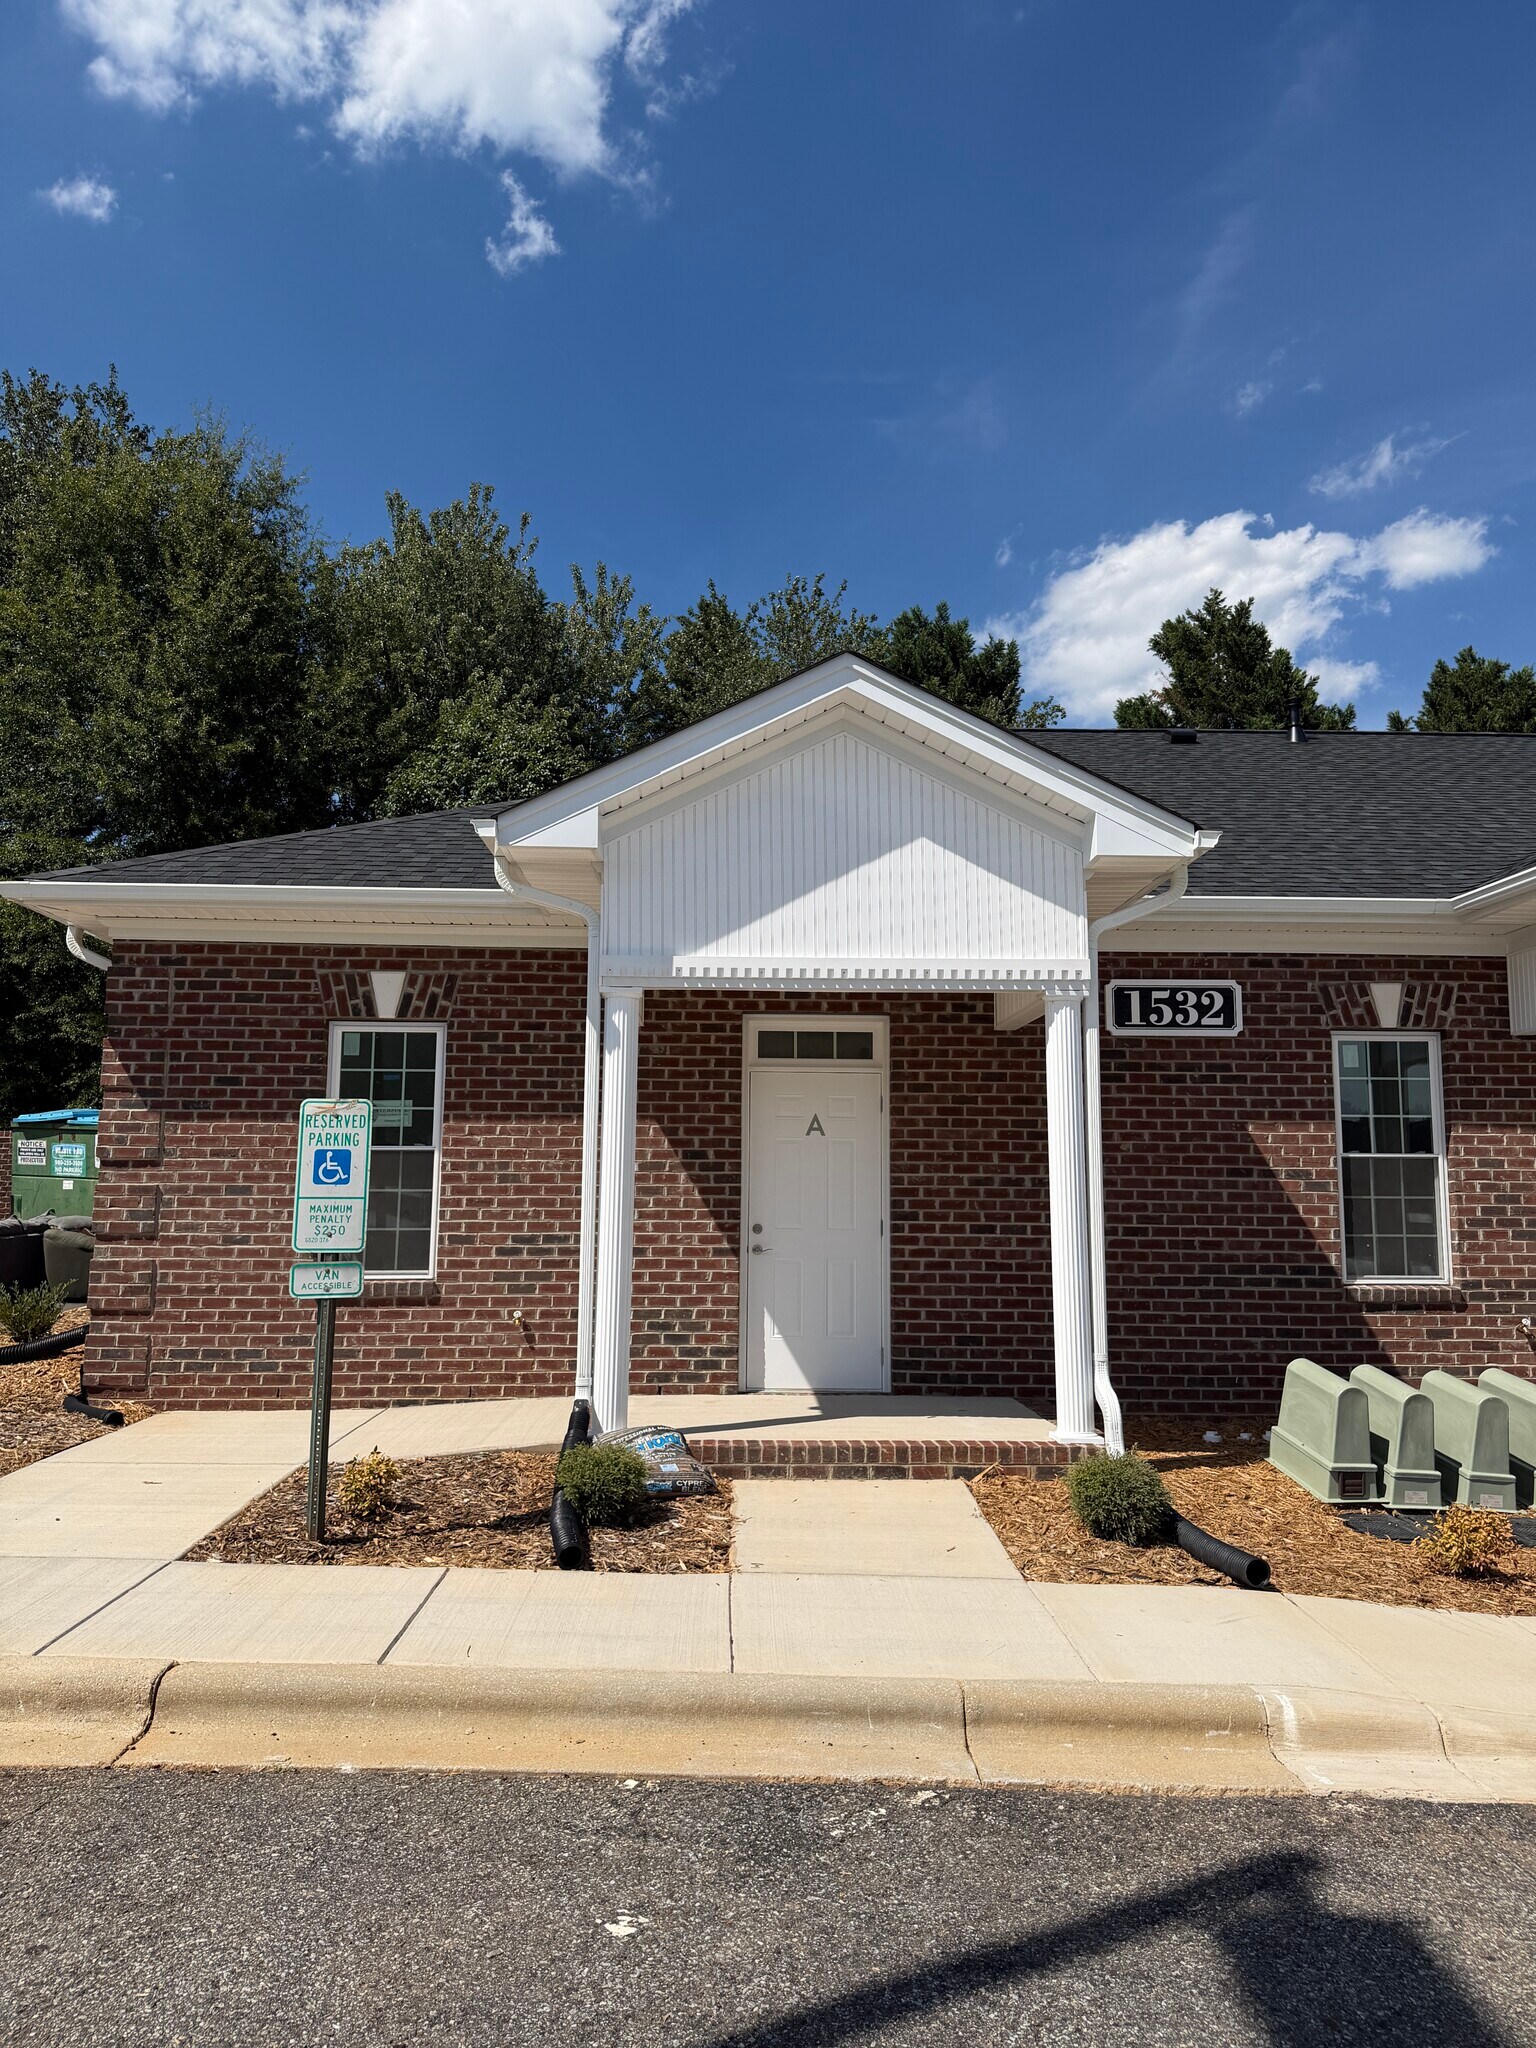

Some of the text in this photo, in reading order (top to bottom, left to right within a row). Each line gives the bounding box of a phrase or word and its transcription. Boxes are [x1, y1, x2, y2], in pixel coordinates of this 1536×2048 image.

[1123, 989, 1224, 1026] 1532
[305, 1114, 366, 1129] RESERVED
[805, 1113, 826, 1137] A
[308, 1132, 360, 1147] PARKING
[309, 1204, 353, 1214] MAXIMUM
[309, 1214, 352, 1224] PENALTY
[314, 1224, 346, 1237] $250
[315, 1269, 340, 1280] VAN
[301, 1281, 353, 1291] ACCESSIBLE
